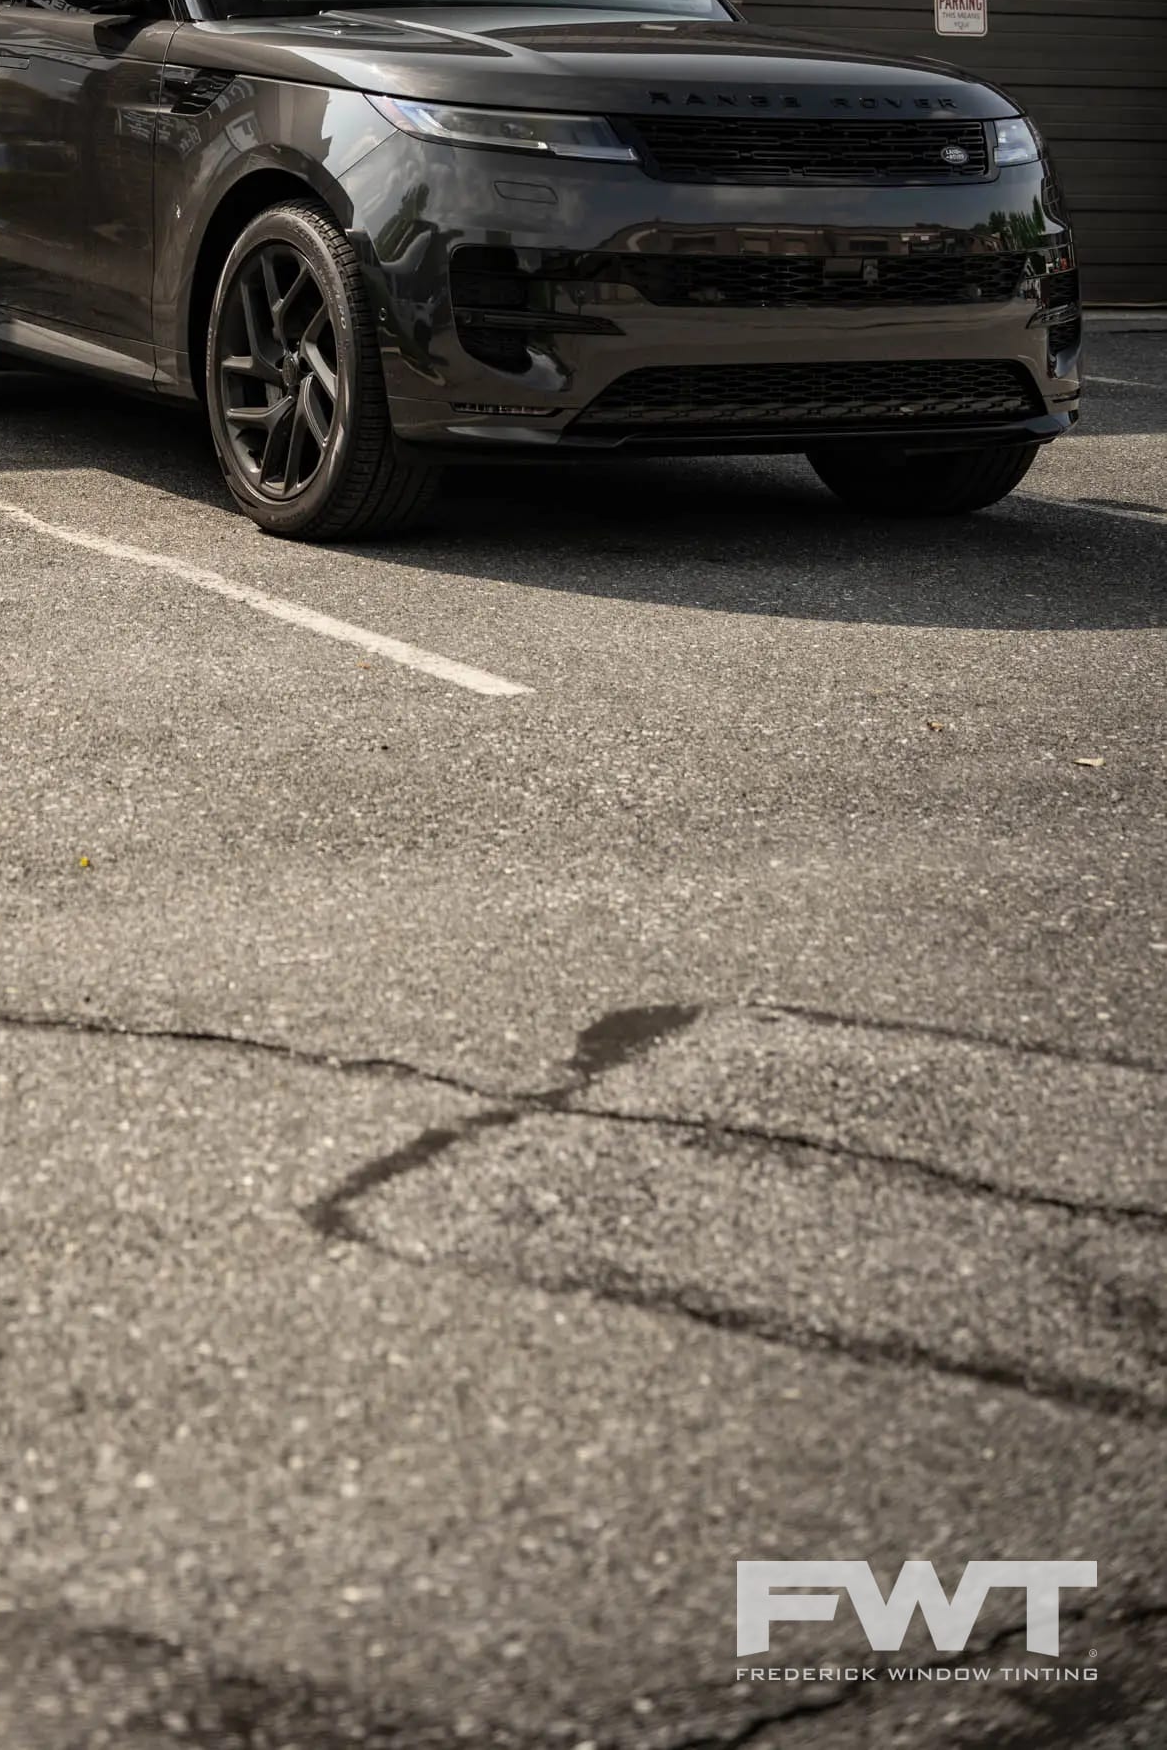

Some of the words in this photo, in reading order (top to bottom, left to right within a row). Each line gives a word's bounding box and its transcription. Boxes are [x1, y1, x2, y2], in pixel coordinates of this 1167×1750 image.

[942, 11, 956, 19] THIS
[957, 11, 980, 20] MEANS
[646, 90, 802, 109] RANGE
[830, 96, 958, 110] ROVER
